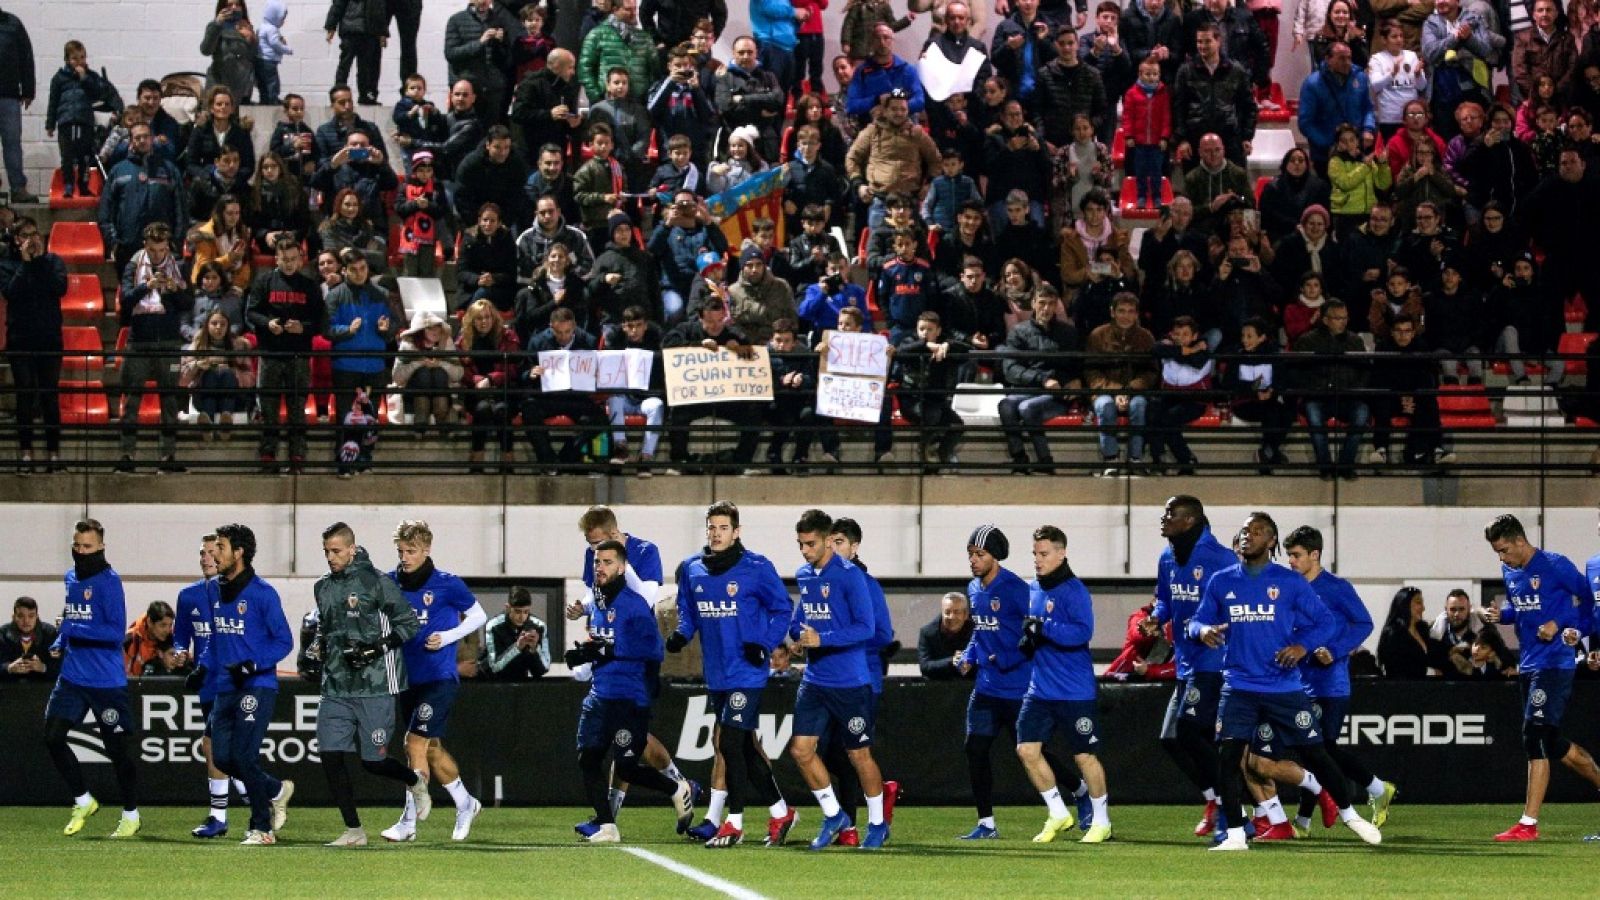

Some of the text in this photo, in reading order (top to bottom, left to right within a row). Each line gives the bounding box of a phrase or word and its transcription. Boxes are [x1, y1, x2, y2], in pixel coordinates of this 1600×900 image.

[683, 366, 768, 382] GUANTES
[672, 386, 698, 400] POR
[704, 384, 726, 397] LOS
[697, 601, 737, 612] BLU
[1229, 604, 1275, 616] BLU
